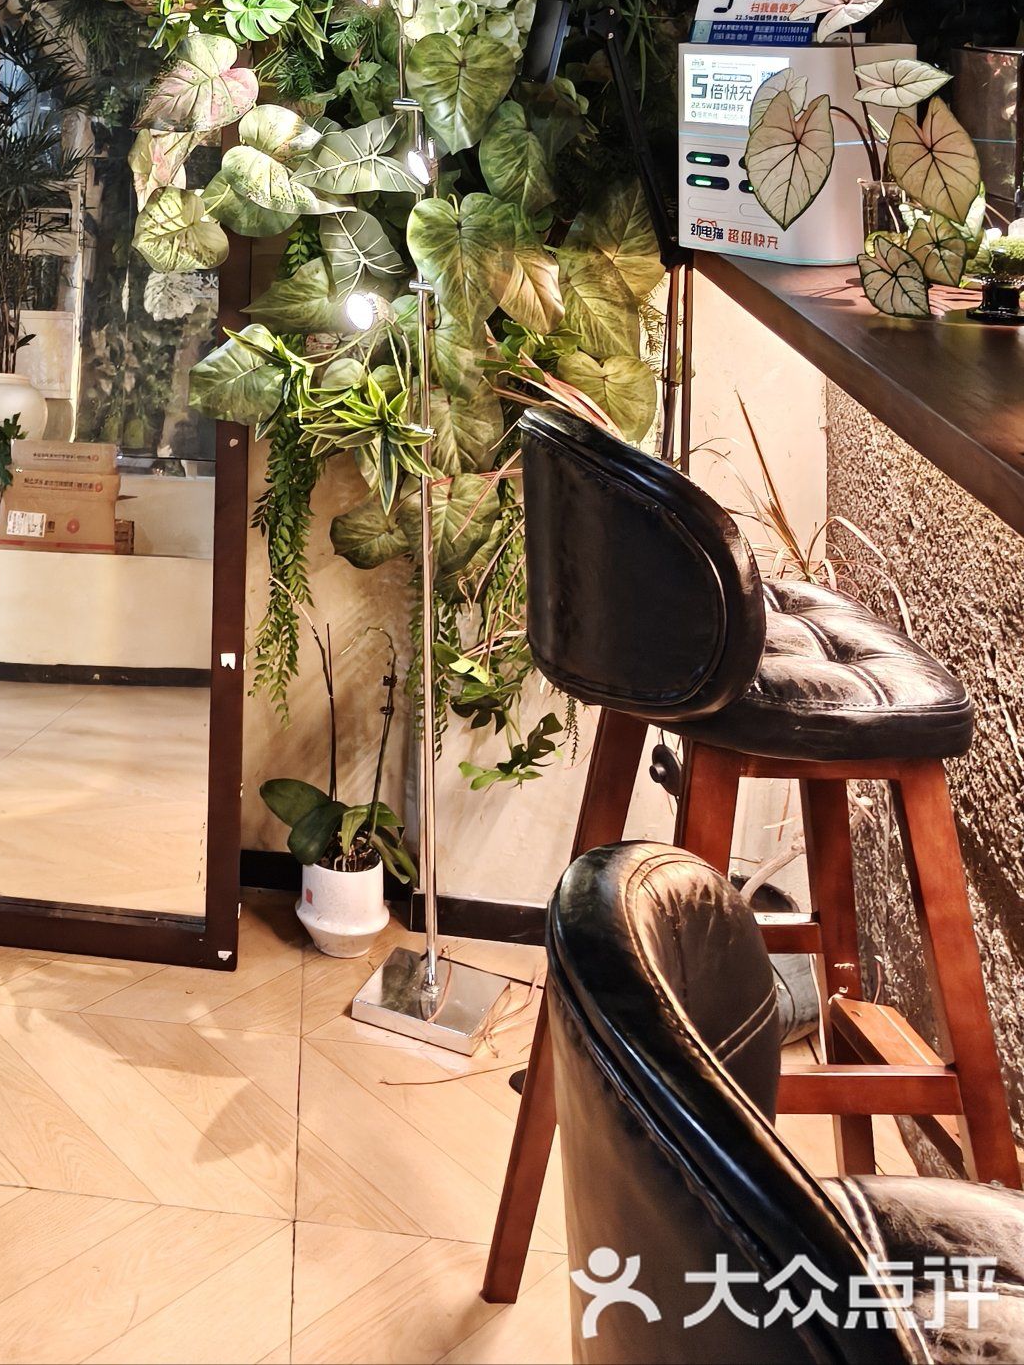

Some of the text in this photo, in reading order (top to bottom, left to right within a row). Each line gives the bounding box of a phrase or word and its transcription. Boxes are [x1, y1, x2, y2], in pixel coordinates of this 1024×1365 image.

[691, 74, 709, 99] 5
[710, 83, 753, 102] 倍快充
[690, 222, 779, 250] 劲电猫 超级快充
